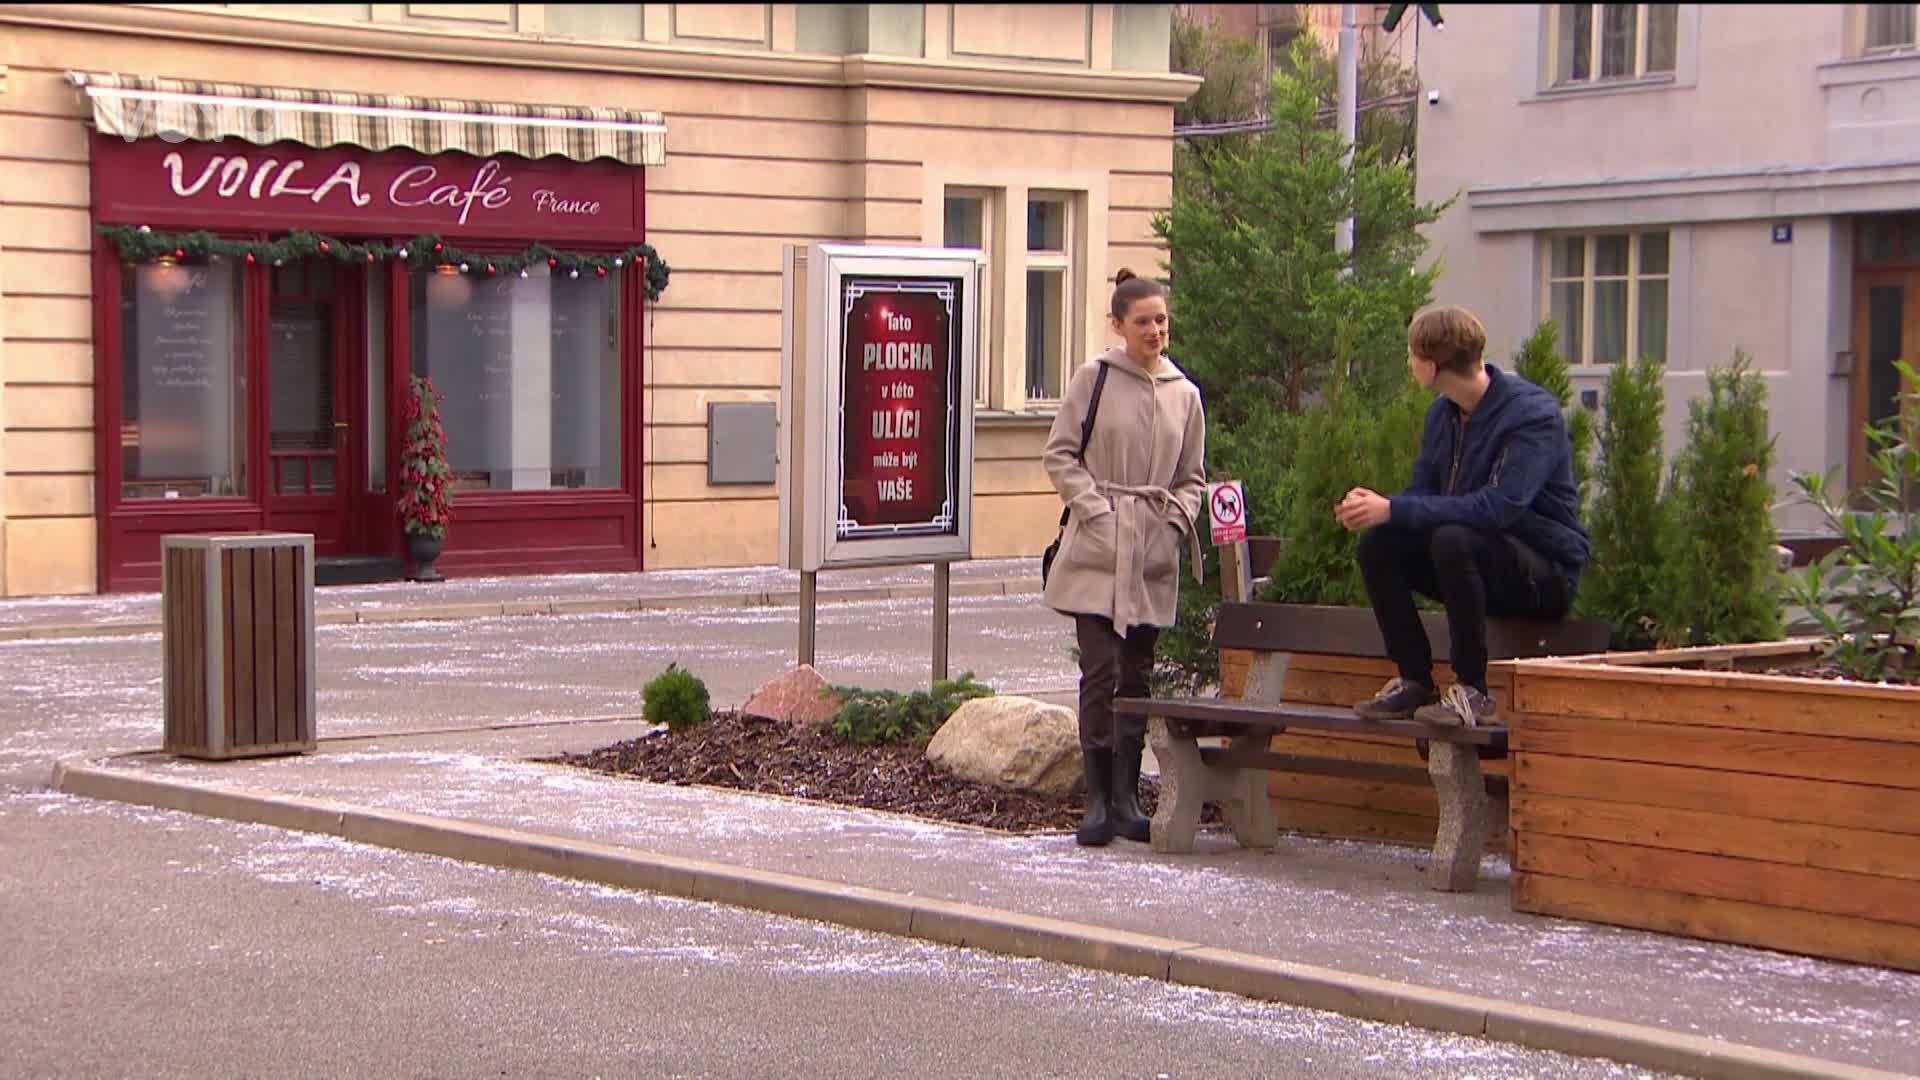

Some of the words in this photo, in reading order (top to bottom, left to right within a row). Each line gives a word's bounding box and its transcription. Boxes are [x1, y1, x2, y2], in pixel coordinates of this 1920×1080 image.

[163, 152, 371, 207] VOILA
[389, 160, 512, 225] Café
[532, 189, 601, 216] France
[887, 311, 912, 331] Tato
[863, 342, 933, 371] PLOCHA
[881, 385, 889, 398] v
[892, 381, 914, 399] této
[872, 408, 921, 439] ULICI
[873, 451, 900, 468] může
[902, 451, 918, 471] být
[877, 475, 913, 501] VAŠE
